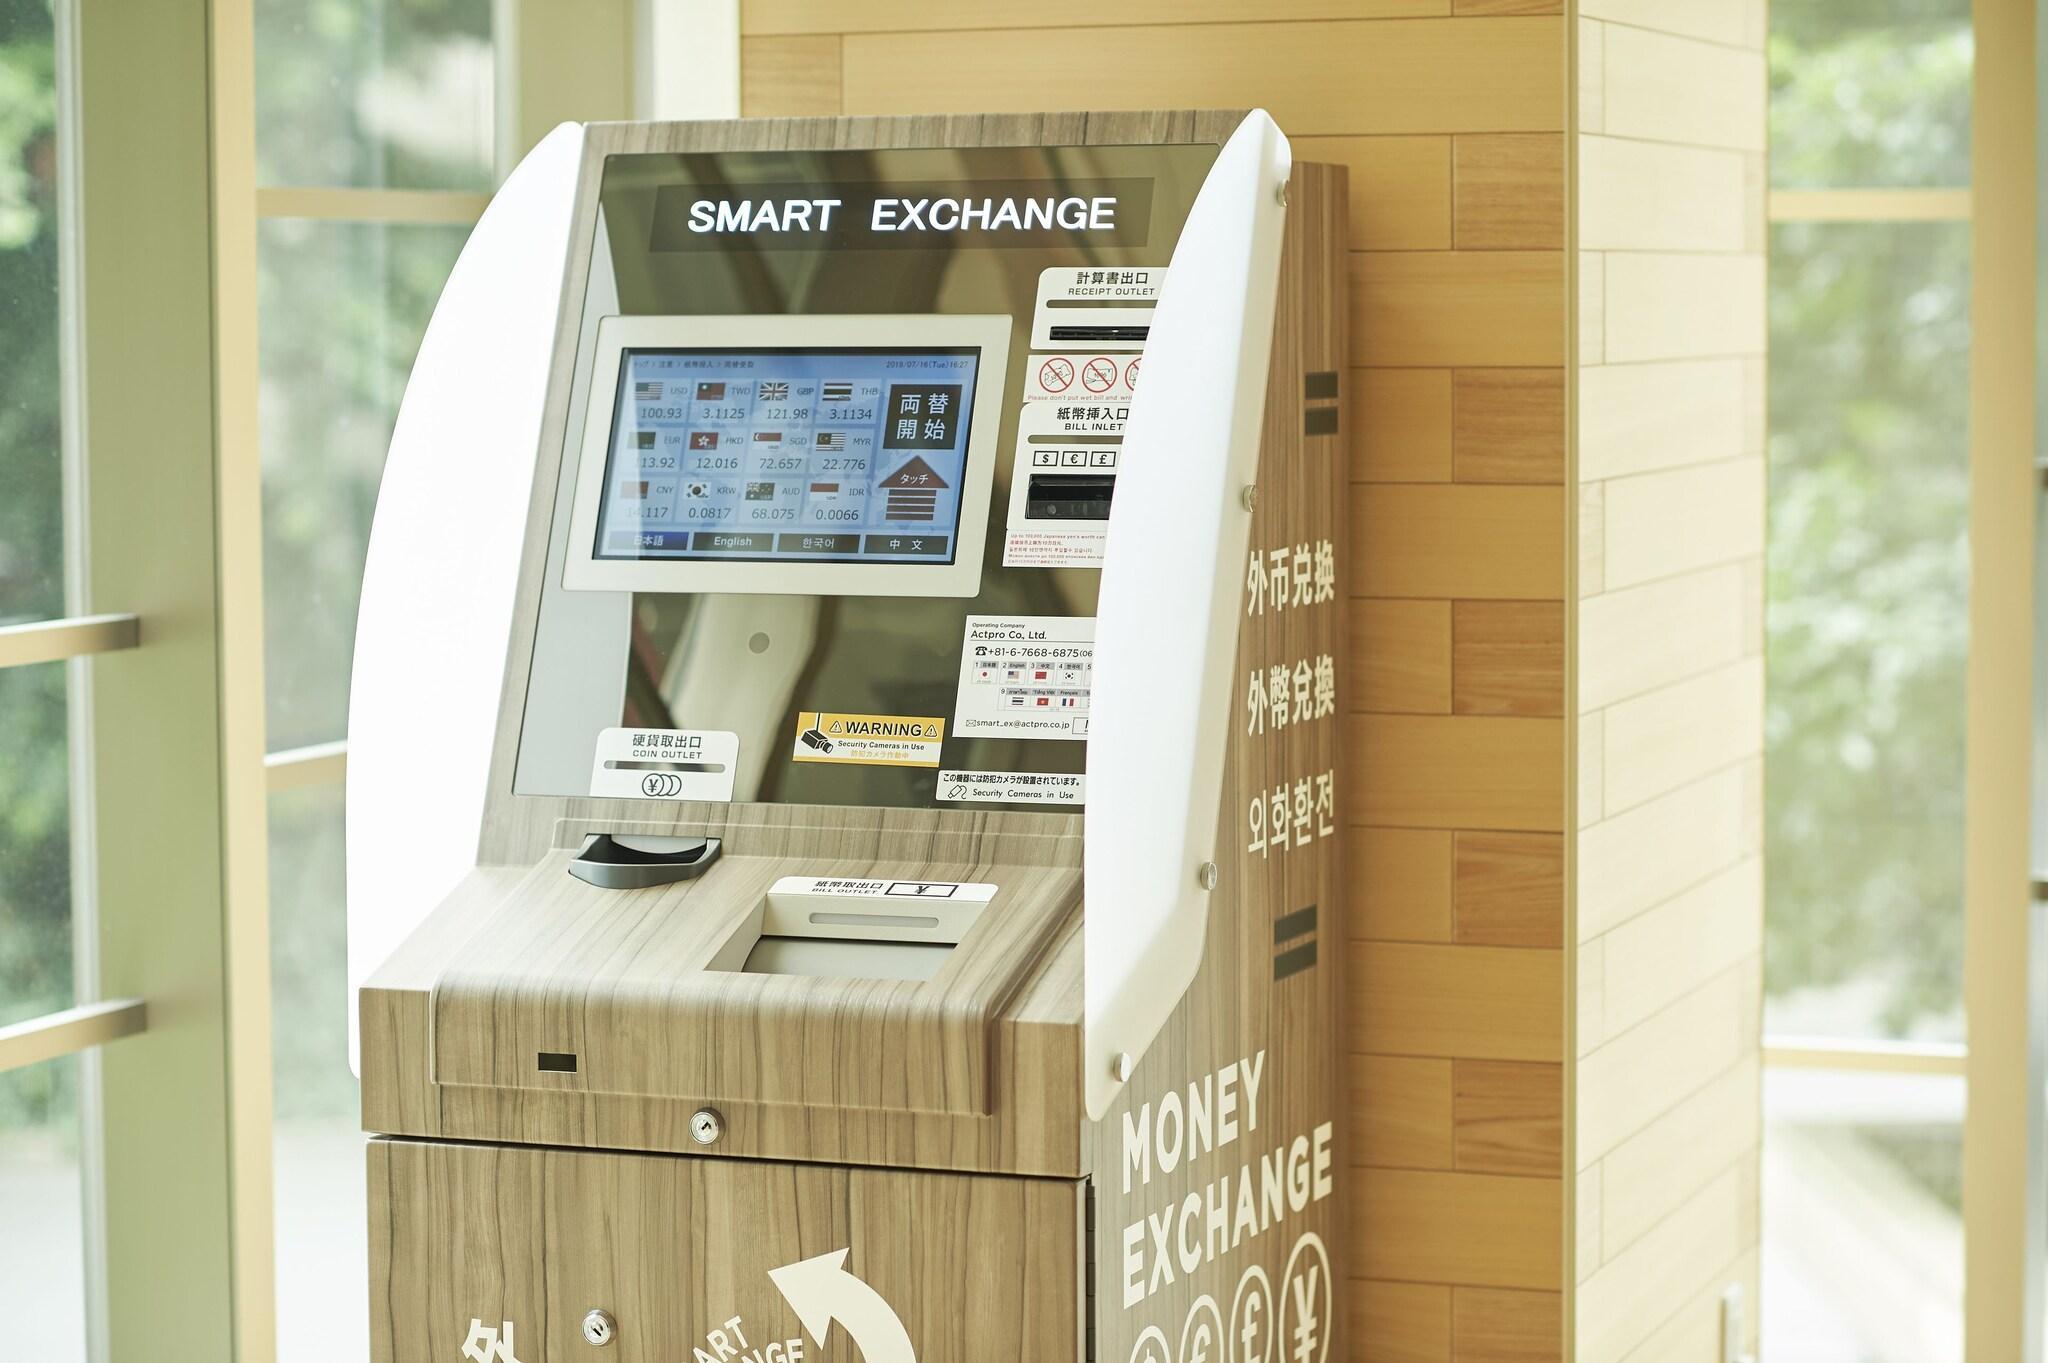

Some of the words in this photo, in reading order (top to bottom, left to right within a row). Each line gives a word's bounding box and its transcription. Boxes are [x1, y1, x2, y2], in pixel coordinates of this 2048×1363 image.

[687, 198, 842, 234] SMART
[870, 196, 1118, 232] EXCHANGE
[1076, 271, 1149, 285] 計算書出口
[1068, 287, 1112, 296] RECEIPT
[1115, 287, 1156, 296] OUTLET
[670, 387, 688, 395] USD
[731, 387, 750, 395] TWD
[796, 387, 815, 395] GBP
[861, 387, 879, 395] THB
[899, 392, 949, 415] 両替
[641, 407, 682, 419] 100.93
[703, 408, 745, 419] 3.1125
[767, 408, 809, 420] 121.98
[829, 408, 872, 420] 3.1134
[1056, 407, 1129, 421] 紙幣挿入口
[896, 418, 946, 440] 開始
[1064, 423, 1087, 431] BILL
[1091, 423, 1124, 431] INLET
[664, 436, 681, 445] EUR
[725, 437, 744, 445] HKD
[788, 437, 808, 446] SGD
[852, 438, 871, 446] MYR
[696, 458, 738, 469] 12.016
[760, 458, 802, 470] 72.657
[1042, 453, 1049, 464] $
[1071, 453, 1079, 464] €
[1099, 454, 1107, 464] £
[822, 459, 866, 470] 22.776
[900, 473, 929, 485] タッチ
[656, 486, 675, 494] CNY
[717, 486, 737, 494] KRW
[782, 487, 800, 495] AUD
[848, 487, 865, 496] IDR
[688, 507, 731, 519] 0.0817
[752, 508, 795, 520] 68.075
[816, 509, 859, 520] 0.0066
[633, 535, 665, 546] 日本語
[714, 536, 753, 548] English
[802, 537, 835, 549] 한국어
[1247, 539, 1335, 617] 外币兑换
[970, 630, 1006, 640] Actpro
[1028, 631, 1047, 640] Ltd.
[846, 721, 922, 737] WARNING
[977, 719, 1070, 729] smart_ex@actpro.co.jp
[632, 733, 702, 748] 硬貨取出口
[838, 740, 867, 748] Security
[869, 741, 900, 750] Cameras
[633, 750, 658, 758] COIN
[661, 751, 702, 759] OUTLET
[943, 773, 1080, 786] この機器には防犯カメラが設置されています。
[972, 788, 1003, 798] Security
[1007, 790, 1042, 798] Cameras
[1046, 790, 1055, 798] in
[1059, 791, 1074, 799] Use
[1248, 769, 1334, 859] 외화환전
[815, 881, 884, 889] 紙幣取出口
[1123, 1050, 1265, 1195] MONEY
[1123, 1121, 1332, 1310] EXCHANGE
